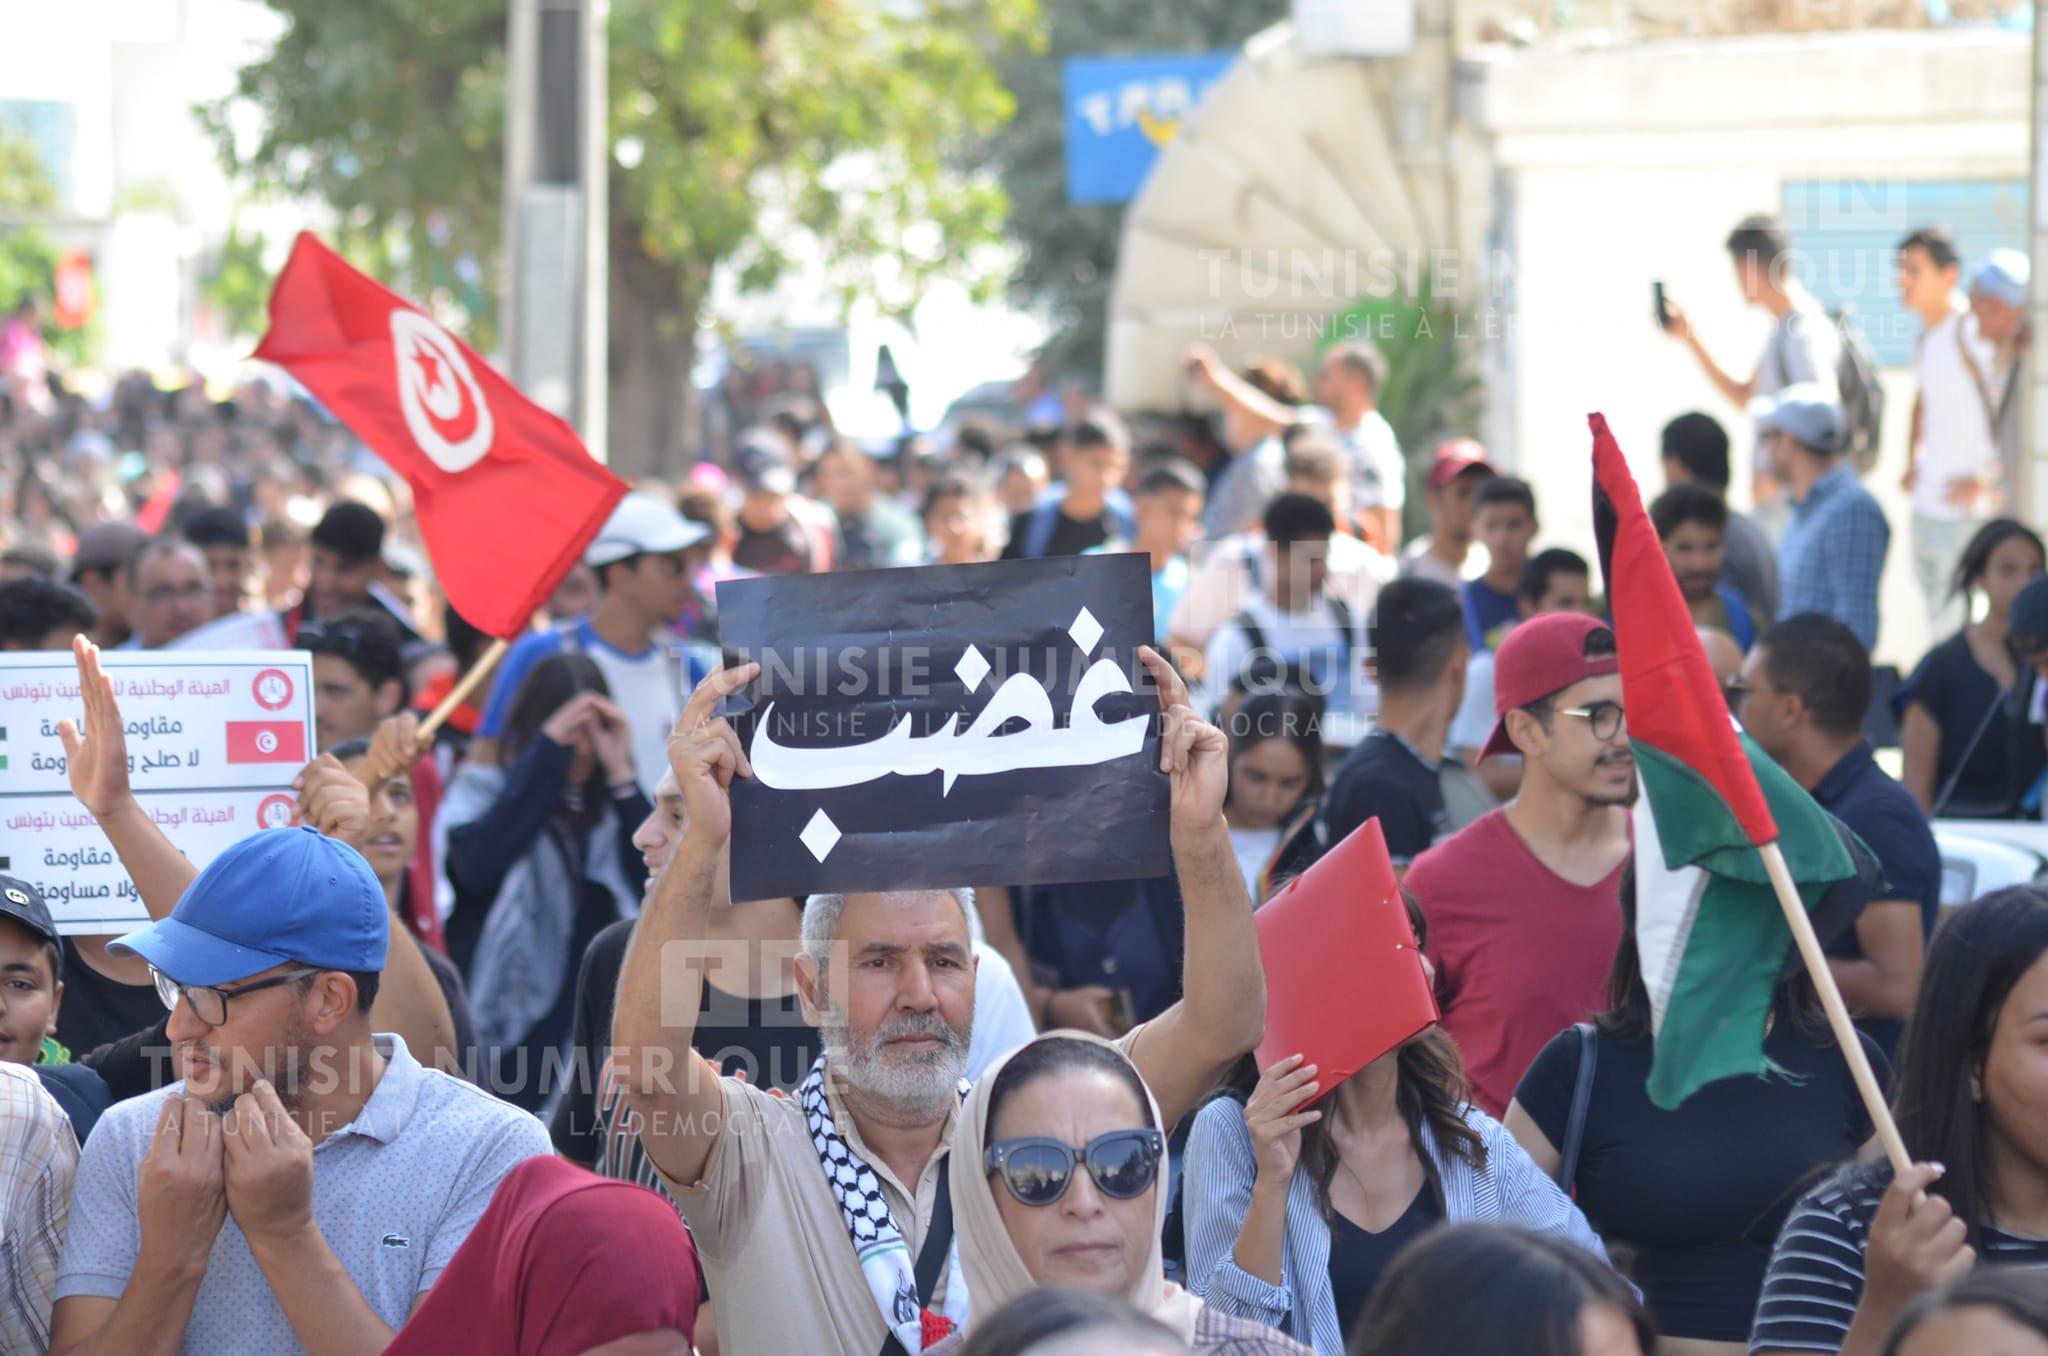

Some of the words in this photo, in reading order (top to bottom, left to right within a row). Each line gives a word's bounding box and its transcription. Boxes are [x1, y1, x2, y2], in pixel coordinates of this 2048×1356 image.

[3, 682, 51, 703] بتونس
[128, 679, 184, 701] الوطنية
[188, 678, 231, 697] الهيئة
[123, 716, 183, 740] مقاوم
[750, 606, 1150, 864] غضب
[140, 749, 181, 773] صلح
[187, 749, 199, 767] لا
[7, 812, 55, 832] بتونس
[192, 806, 235, 827] الهيئة
[44, 846, 112, 871] مقاومة
